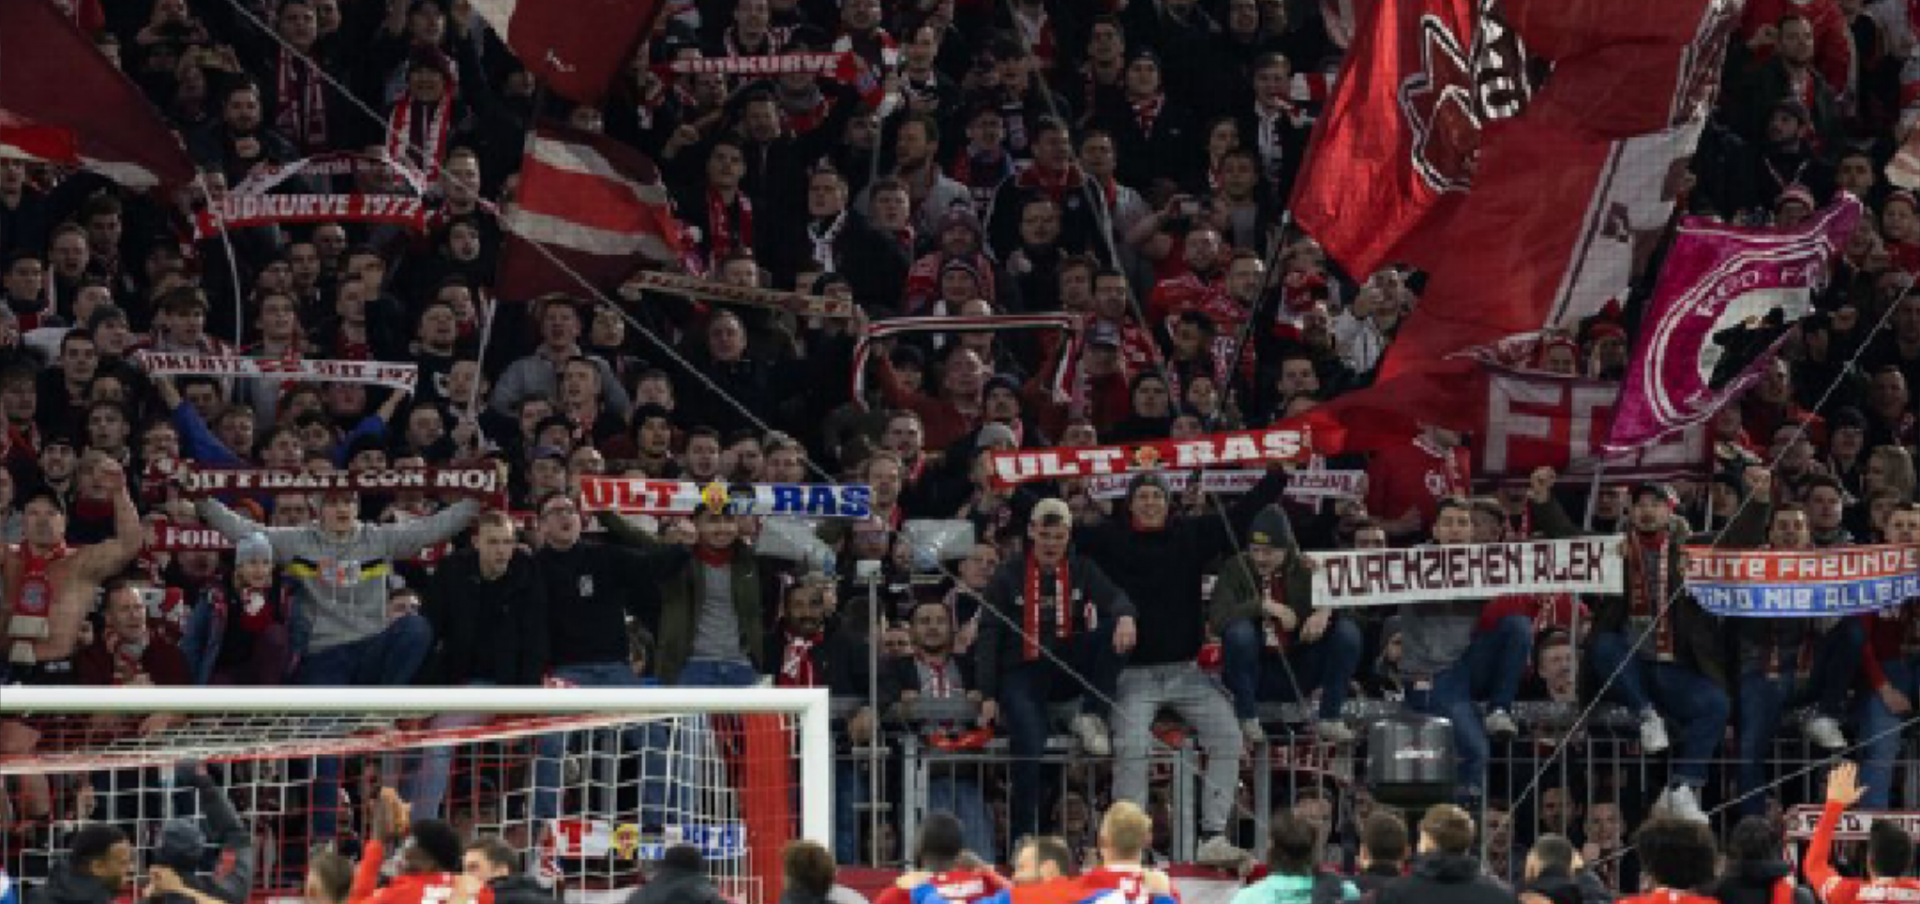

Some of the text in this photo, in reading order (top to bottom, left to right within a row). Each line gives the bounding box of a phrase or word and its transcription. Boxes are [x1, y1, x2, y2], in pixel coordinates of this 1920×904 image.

[995, 429, 1301, 482] ULT RAS
[357, 471, 424, 488] CON
[436, 469, 498, 492] NOI
[581, 480, 871, 515] ULT RAS
[1326, 546, 1523, 596] DURCHZIEHEN
